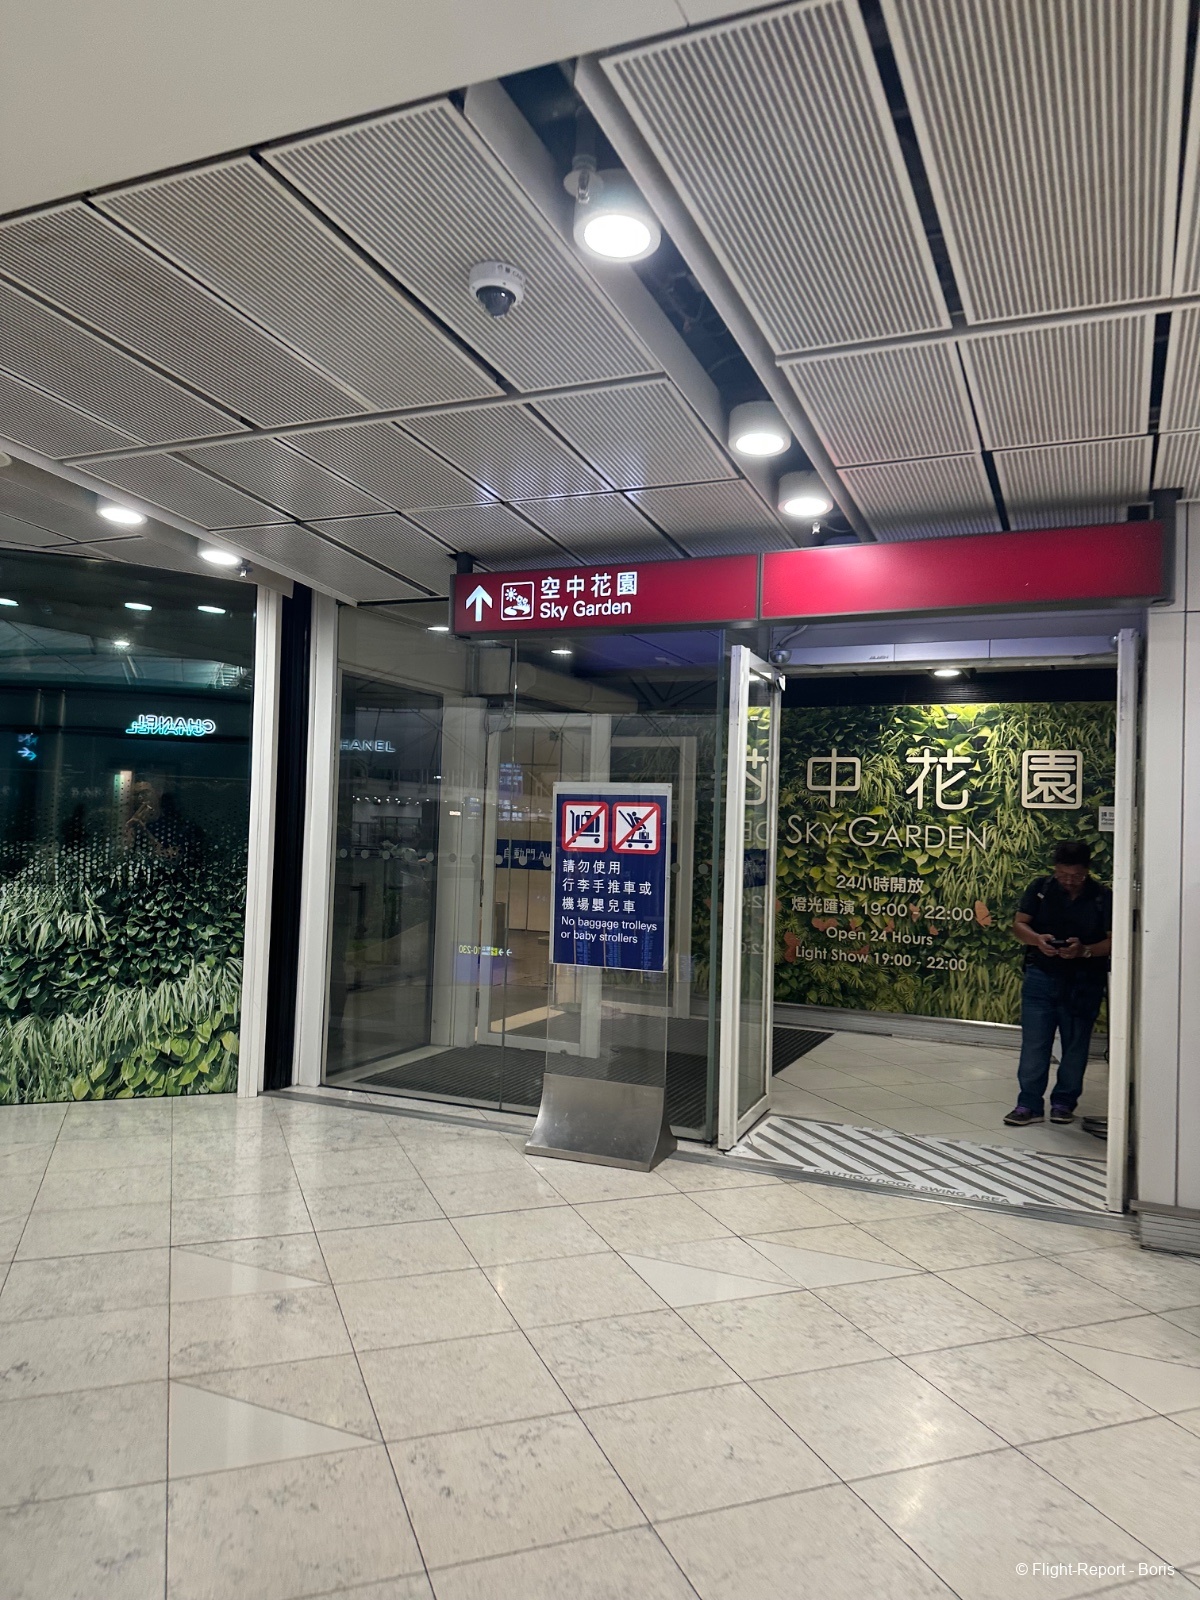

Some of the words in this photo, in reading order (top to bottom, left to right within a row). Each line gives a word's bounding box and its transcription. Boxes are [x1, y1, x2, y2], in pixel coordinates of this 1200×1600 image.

[540, 571, 638, 599] 空中花園
[540, 602, 568, 621] Sky
[573, 599, 631, 617] Garden
[340, 739, 396, 753] HANEL
[807, 748, 1084, 811] 中花園
[848, 816, 987, 850] GARDEN
[503, 847, 536, 861] 自動門
[538, 851, 552, 860] Au
[562, 858, 621, 875] 請勿使用
[562, 878, 652, 896] 行李手推車或
[836, 875, 925, 894] 24小時開放
[561, 896, 636, 913] 機場嬰兒車
[791, 896, 855, 916] 燈光匯演
[861, 902, 908, 917] 19:00
[924, 905, 974, 921] 22:00
[561, 916, 575, 927] No
[577, 916, 619, 930] baggage
[621, 920, 658, 933] trolleys
[560, 931, 571, 939] or
[573, 929, 596, 943] baby
[599, 931, 638, 944] strollers
[825, 926, 866, 942] Open
[870, 930, 887, 942] 24
[892, 931, 933, 946] Hours
[795, 945, 828, 962] Light
[831, 949, 869, 964] Show
[873, 952, 912, 967] 19:00
[926, 956, 967, 972] 22:00
[813, 1168, 873, 1182] CAUTION
[875, 1178, 918, 1189] DOOR
[920, 1185, 966, 1197] SWING
[971, 1192, 1010, 1203] AREA
